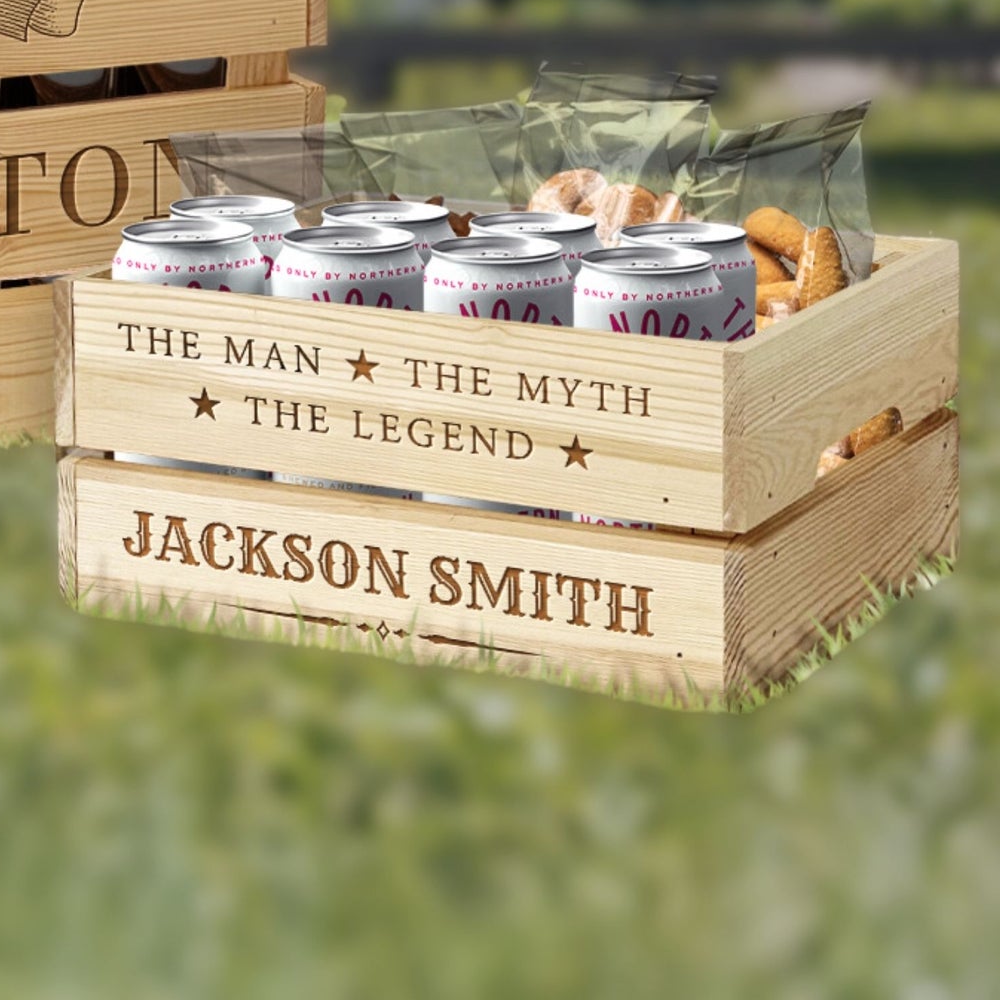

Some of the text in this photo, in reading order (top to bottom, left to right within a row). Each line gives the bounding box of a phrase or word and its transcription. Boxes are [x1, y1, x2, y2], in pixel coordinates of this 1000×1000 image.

[126, 259, 158, 272] ONLY
[164, 264, 181, 273] BY
[188, 258, 256, 273] NORTHERN
[286, 267, 318, 279] ONLY
[325, 272, 341, 281] BY
[349, 265, 417, 281] NORTHERN
[433, 277, 464, 289] ONLY
[472, 282, 489, 291] BY
[495, 276, 564, 291] NORTHERN
[583, 287, 614, 300] ONLY
[621, 293, 639, 302] BY
[645, 286, 714, 301] NORTHERN
[118, 322, 652, 417] THE MAN THE MYTH
[244, 394, 534, 460] THE LEGEND
[122, 510, 654, 638] JACKSON SMITH
